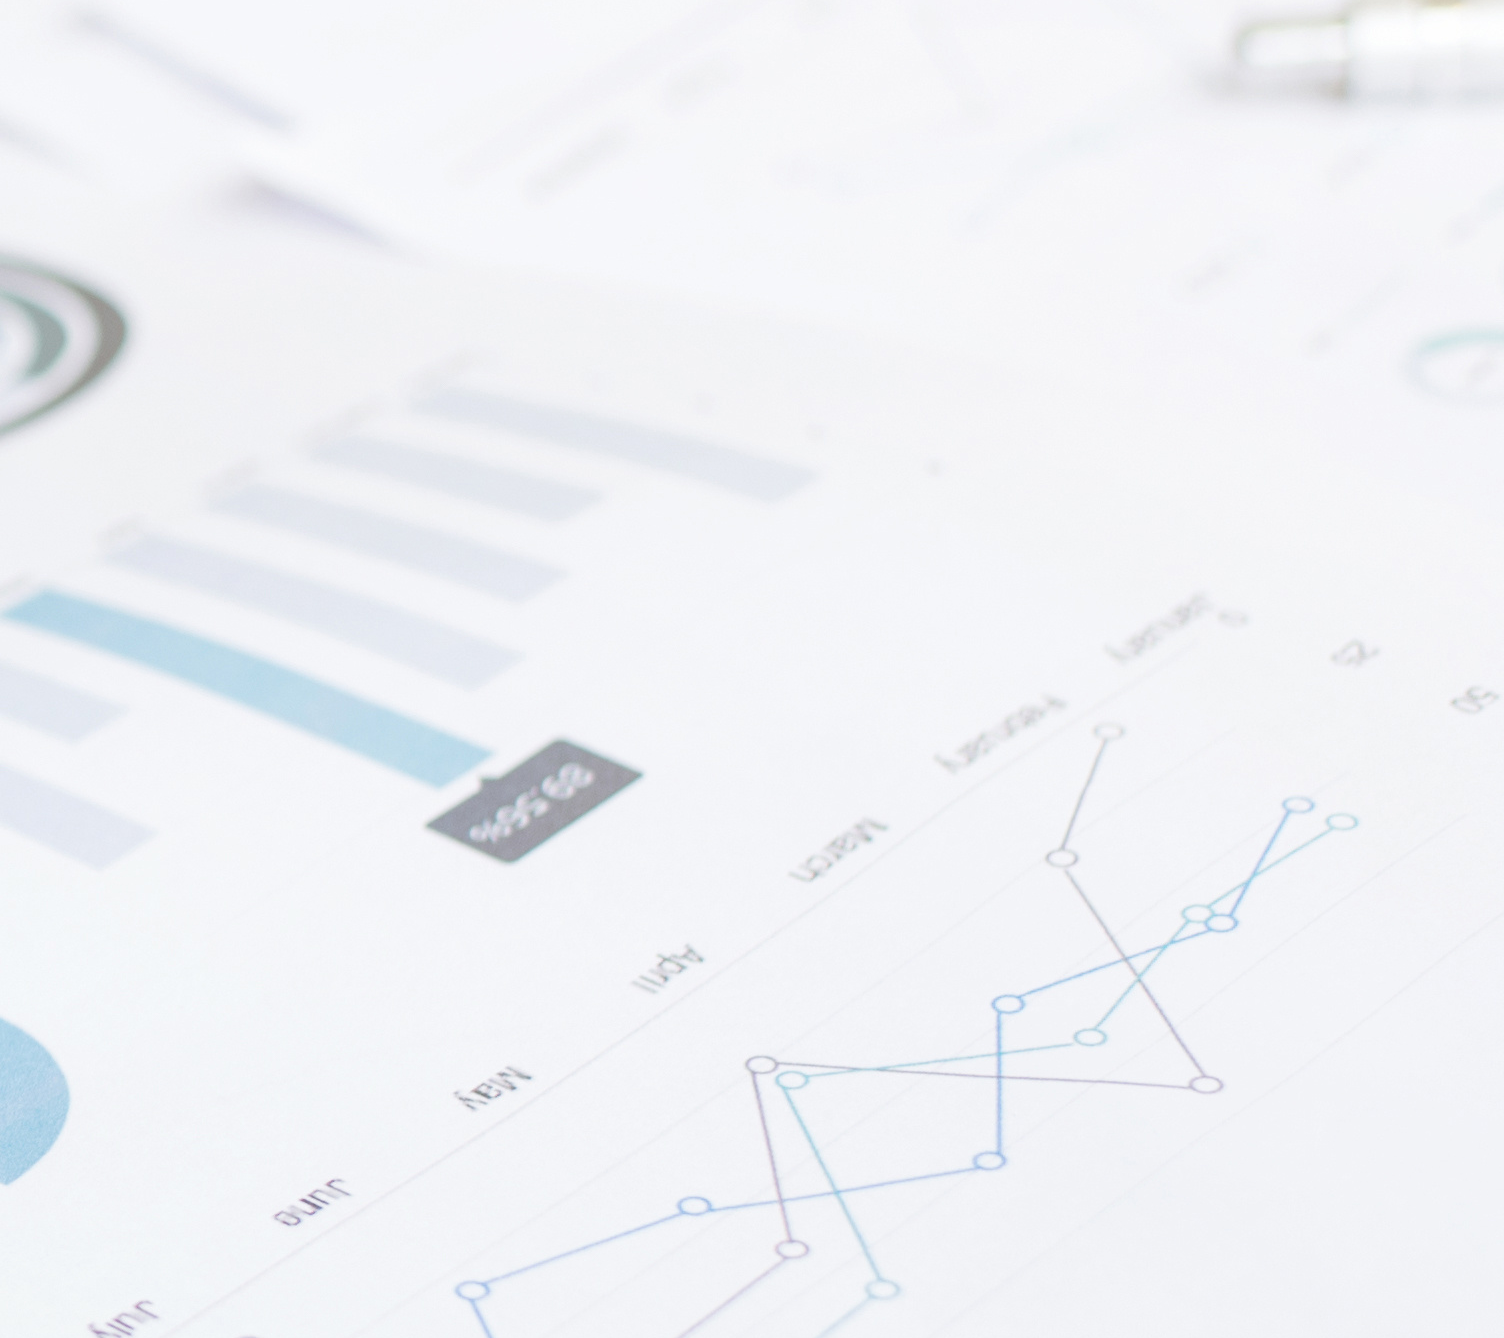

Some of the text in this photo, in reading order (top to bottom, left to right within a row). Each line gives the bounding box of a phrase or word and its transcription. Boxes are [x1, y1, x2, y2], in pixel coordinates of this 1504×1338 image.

[788, 817, 891, 885] March
[632, 943, 707, 995] April
[453, 1065, 535, 1113] May
